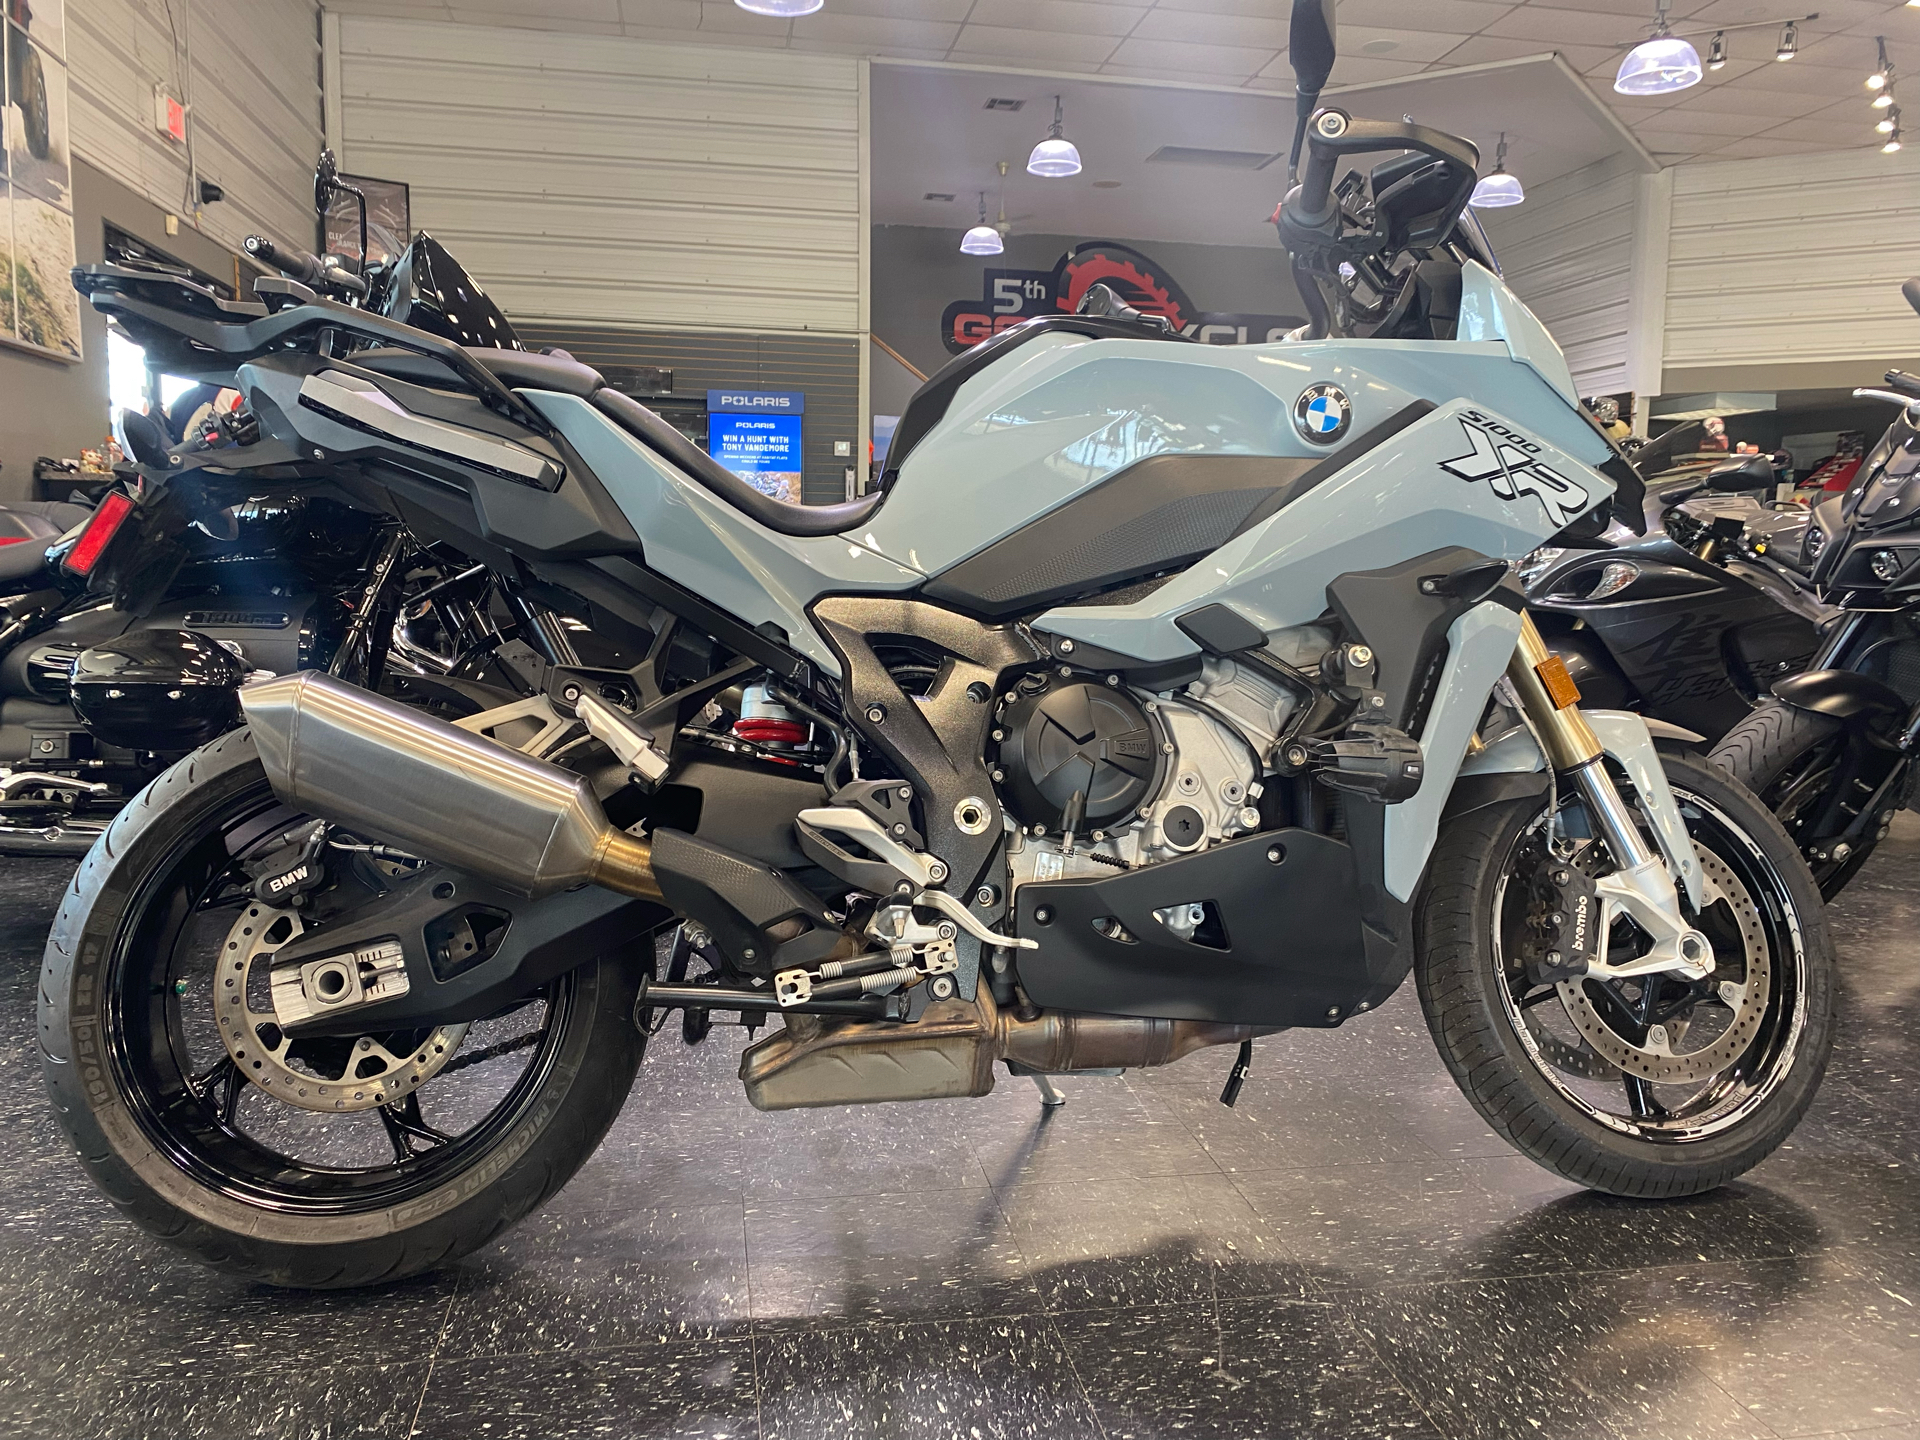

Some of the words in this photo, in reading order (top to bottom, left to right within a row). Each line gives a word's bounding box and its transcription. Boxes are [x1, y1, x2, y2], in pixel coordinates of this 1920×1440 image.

[993, 278, 1046, 314] 5th
[721, 396, 790, 406] POLARIS
[1305, 386, 1350, 410] BMW
[722, 434, 738, 443] WIN
[740, 435, 745, 443] A
[747, 435, 767, 443] HUNT
[769, 436, 789, 444] WITH
[722, 443, 742, 451] TONY
[744, 443, 789, 452] VANDEMORE
[1459, 410, 1541, 453] S1000
[1436, 417, 1588, 528] XR
[1119, 742, 1147, 752] BMW
[269, 865, 308, 892] BMW
[1571, 895, 1588, 951] brembo
[77, 973, 94, 1006] ZR
[78, 1025, 109, 1101] 190/50
[463, 1103, 550, 1193] MICHELIN
